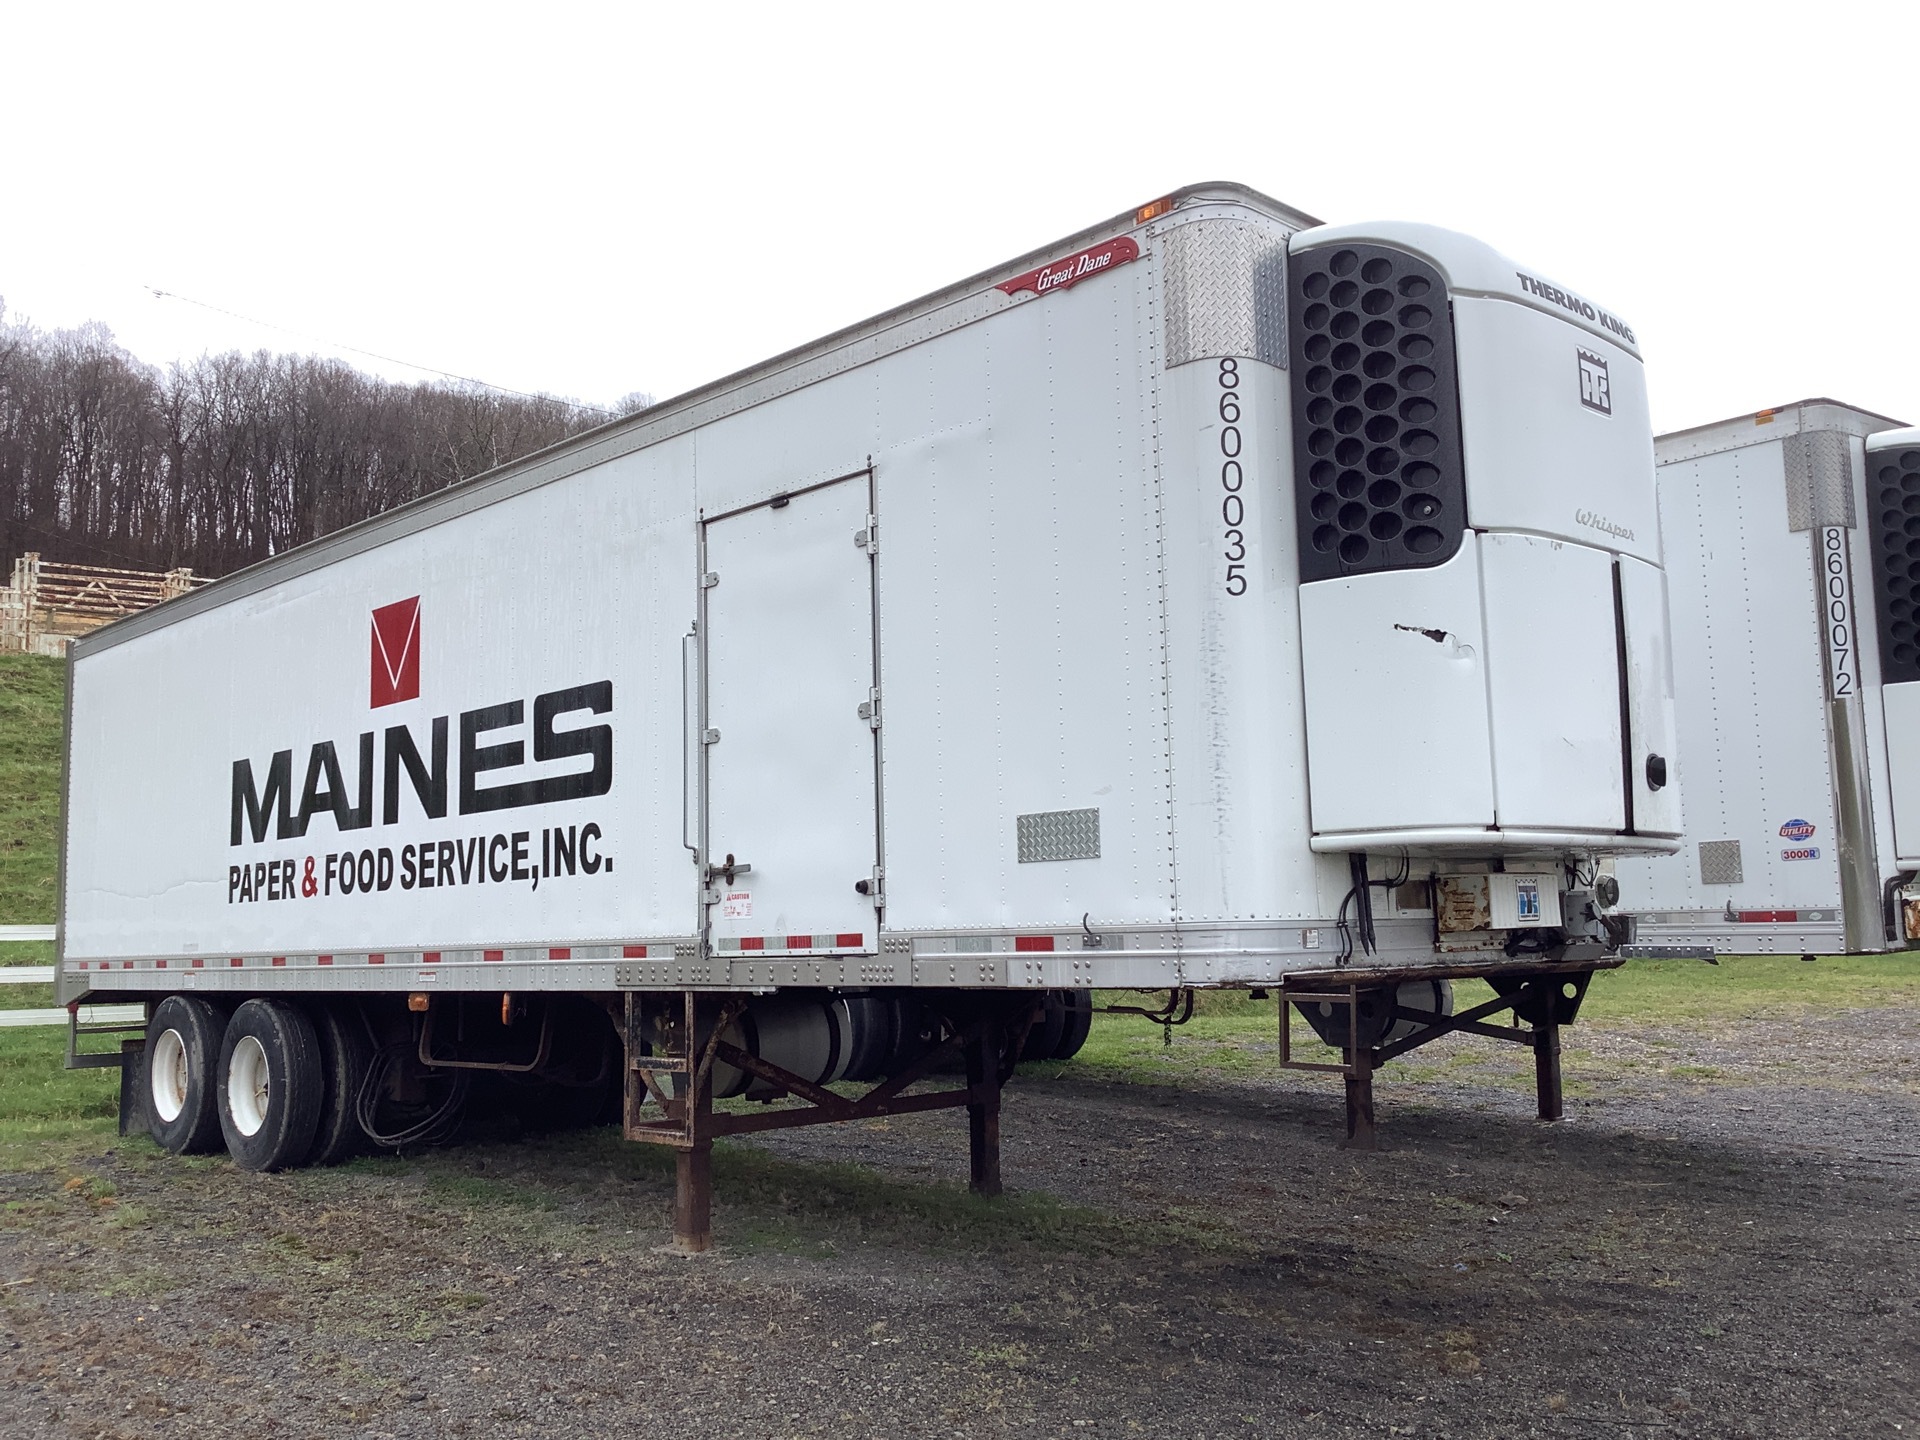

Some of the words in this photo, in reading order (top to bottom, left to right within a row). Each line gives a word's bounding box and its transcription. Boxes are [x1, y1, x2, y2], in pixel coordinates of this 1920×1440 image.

[1037, 263, 1075, 290] Great
[1075, 252, 1112, 277] Dane
[1516, 271, 1596, 321] THERMO
[1597, 309, 1636, 344] KING
[1218, 357, 1248, 597] 8600035
[1575, 508, 1635, 541] Whisper
[1826, 528, 1853, 696] 8600072
[230, 679, 613, 846] MAINES
[1780, 826, 1814, 836] UTILITY
[1783, 849, 1816, 860] 3000R
[228, 859, 296, 904] PAPER
[301, 855, 319, 898] &
[324, 847, 394, 896] FOOD
